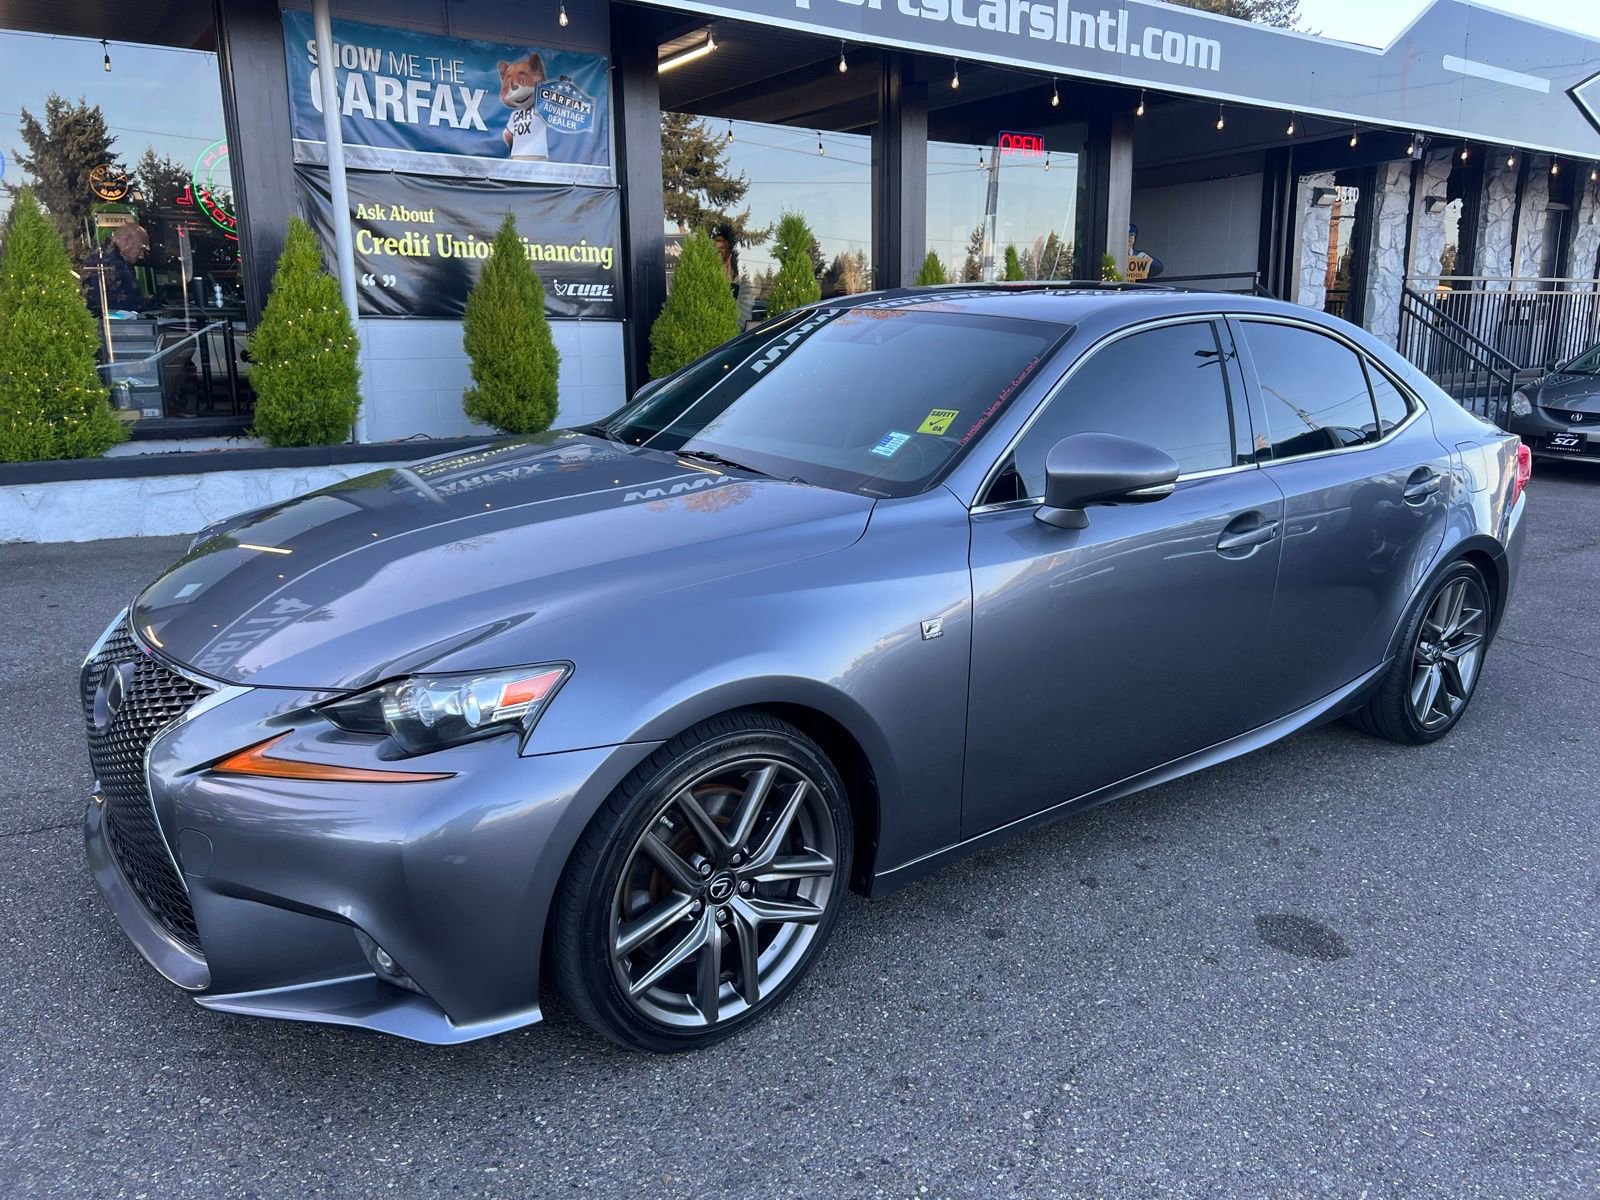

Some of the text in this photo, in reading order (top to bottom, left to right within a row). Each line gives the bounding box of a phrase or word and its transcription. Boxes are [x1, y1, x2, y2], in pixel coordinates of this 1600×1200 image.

[389, 52, 421, 78] ME
[426, 57, 465, 84] THE
[310, 67, 489, 131] CARFAX
[542, 90, 591, 114] CARFAX
[544, 102, 585, 123] ADVANTAGE
[548, 115, 577, 130] DEALER
[514, 122, 531, 136] FOX
[1001, 134, 1042, 159] OPEN
[356, 203, 434, 224] Ask About
[356, 229, 430, 258] Credit
[520, 237, 613, 270] inancing
[931, 410, 956, 418] SAFETY
